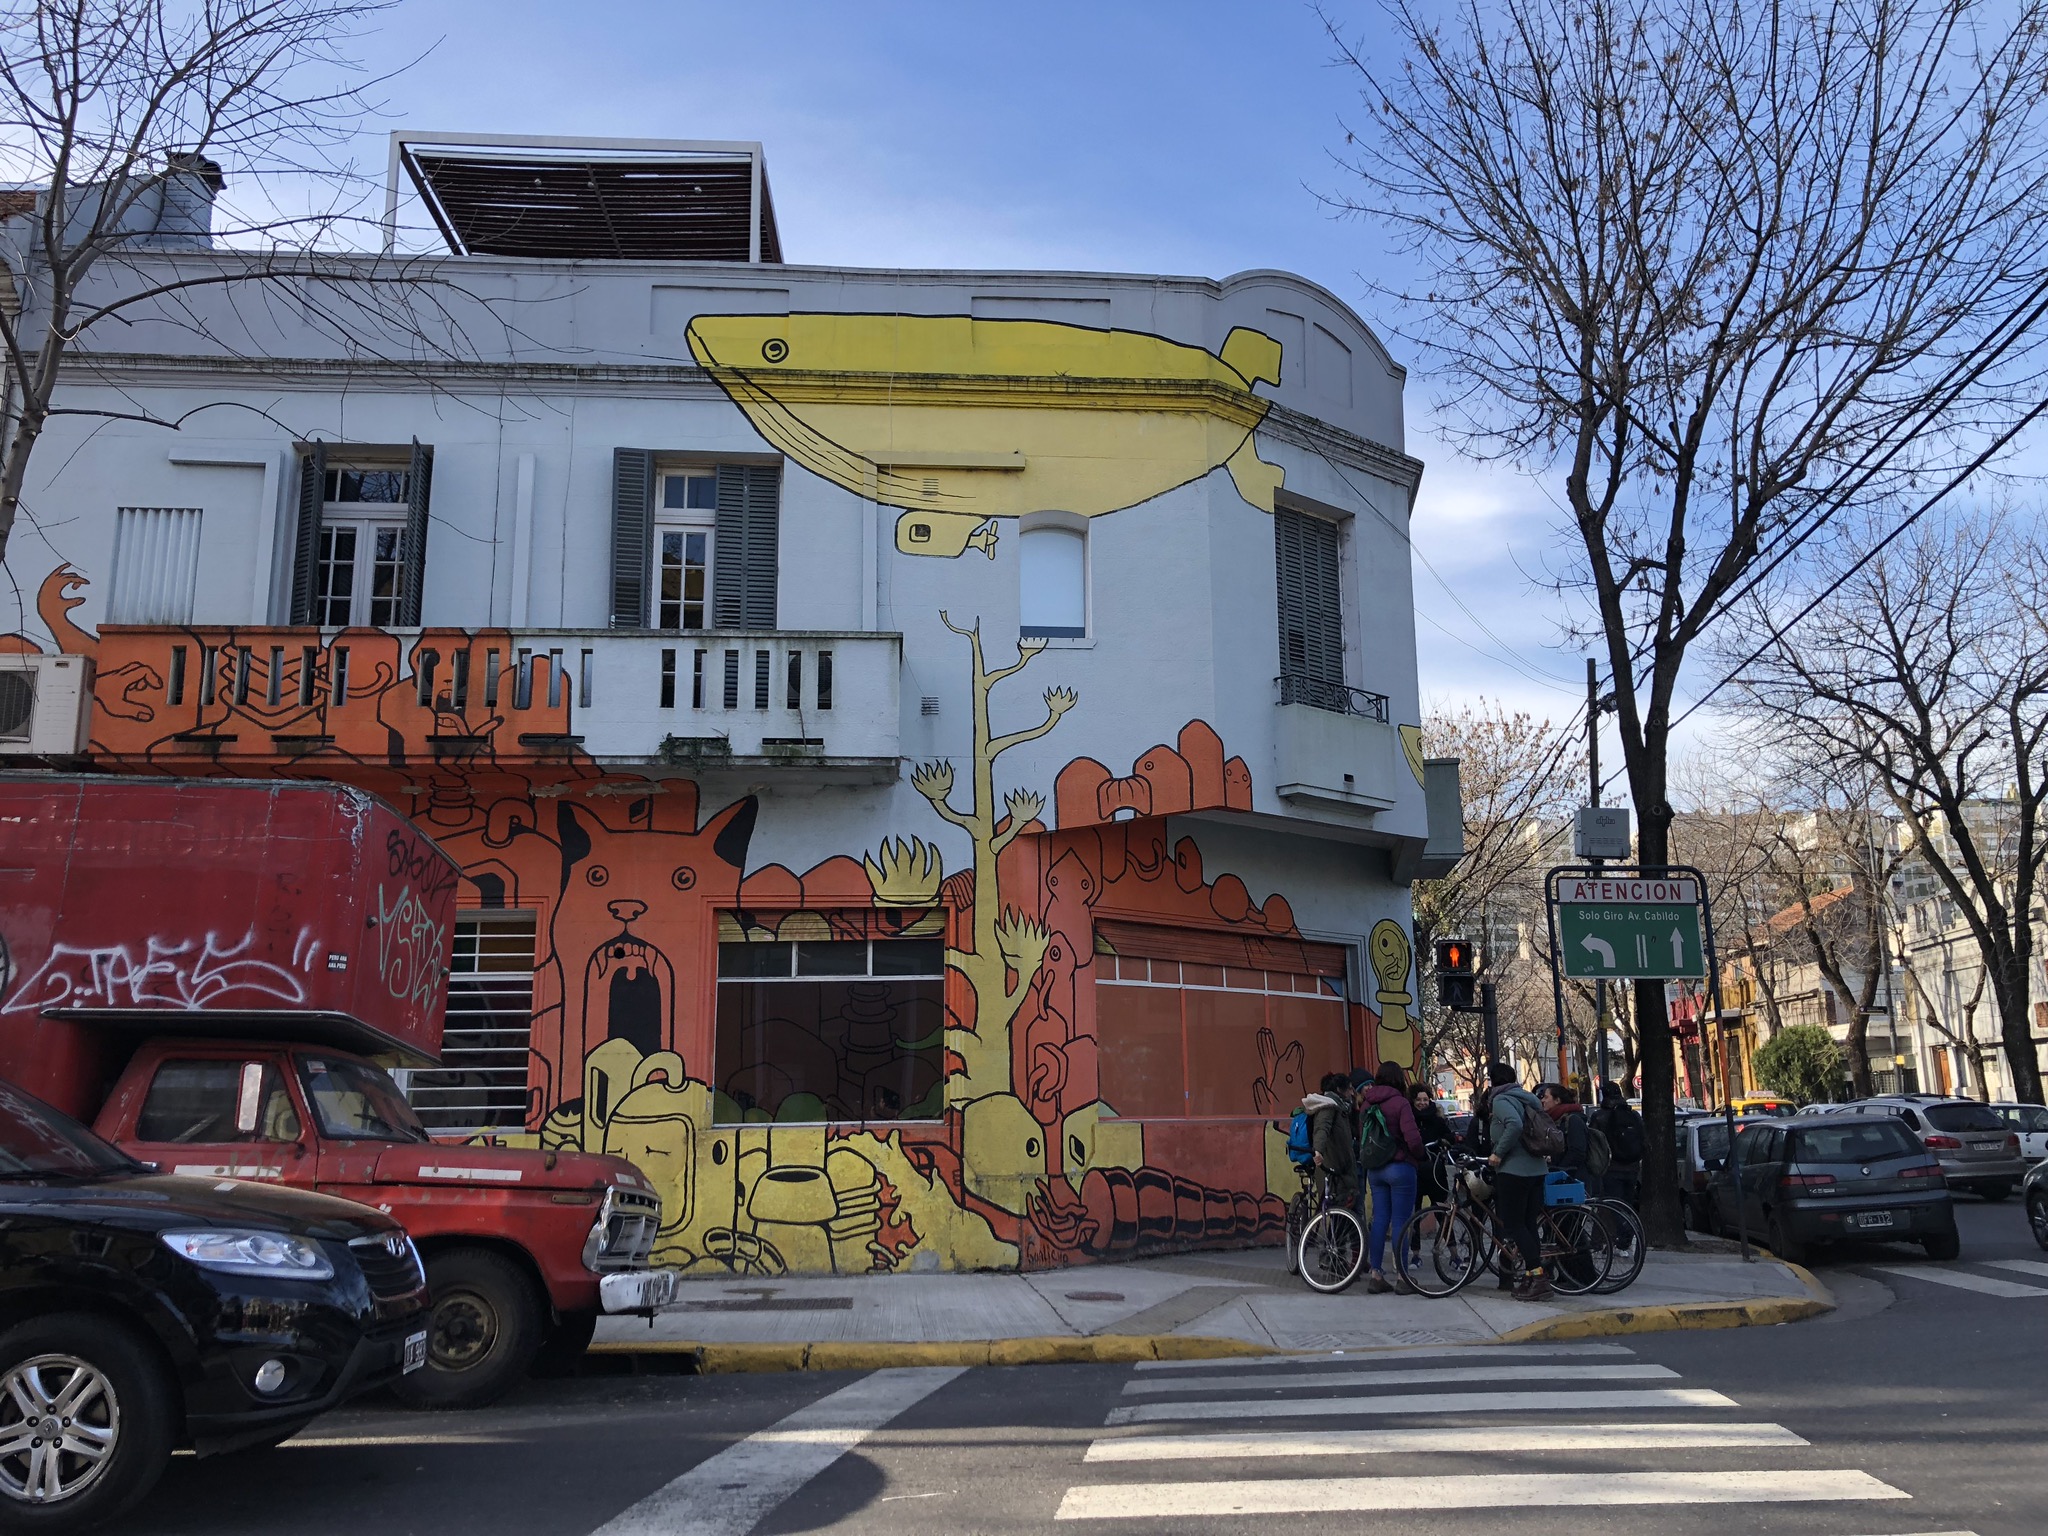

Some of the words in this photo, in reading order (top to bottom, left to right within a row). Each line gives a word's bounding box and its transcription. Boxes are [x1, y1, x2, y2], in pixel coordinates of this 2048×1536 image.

[1574, 882, 1682, 901] ATENCION
[1579, 910, 1600, 921] Solo
[1603, 910, 1624, 921] Giro
[1628, 911, 1642, 921] Av.
[1644, 910, 1680, 921] Cabildo
